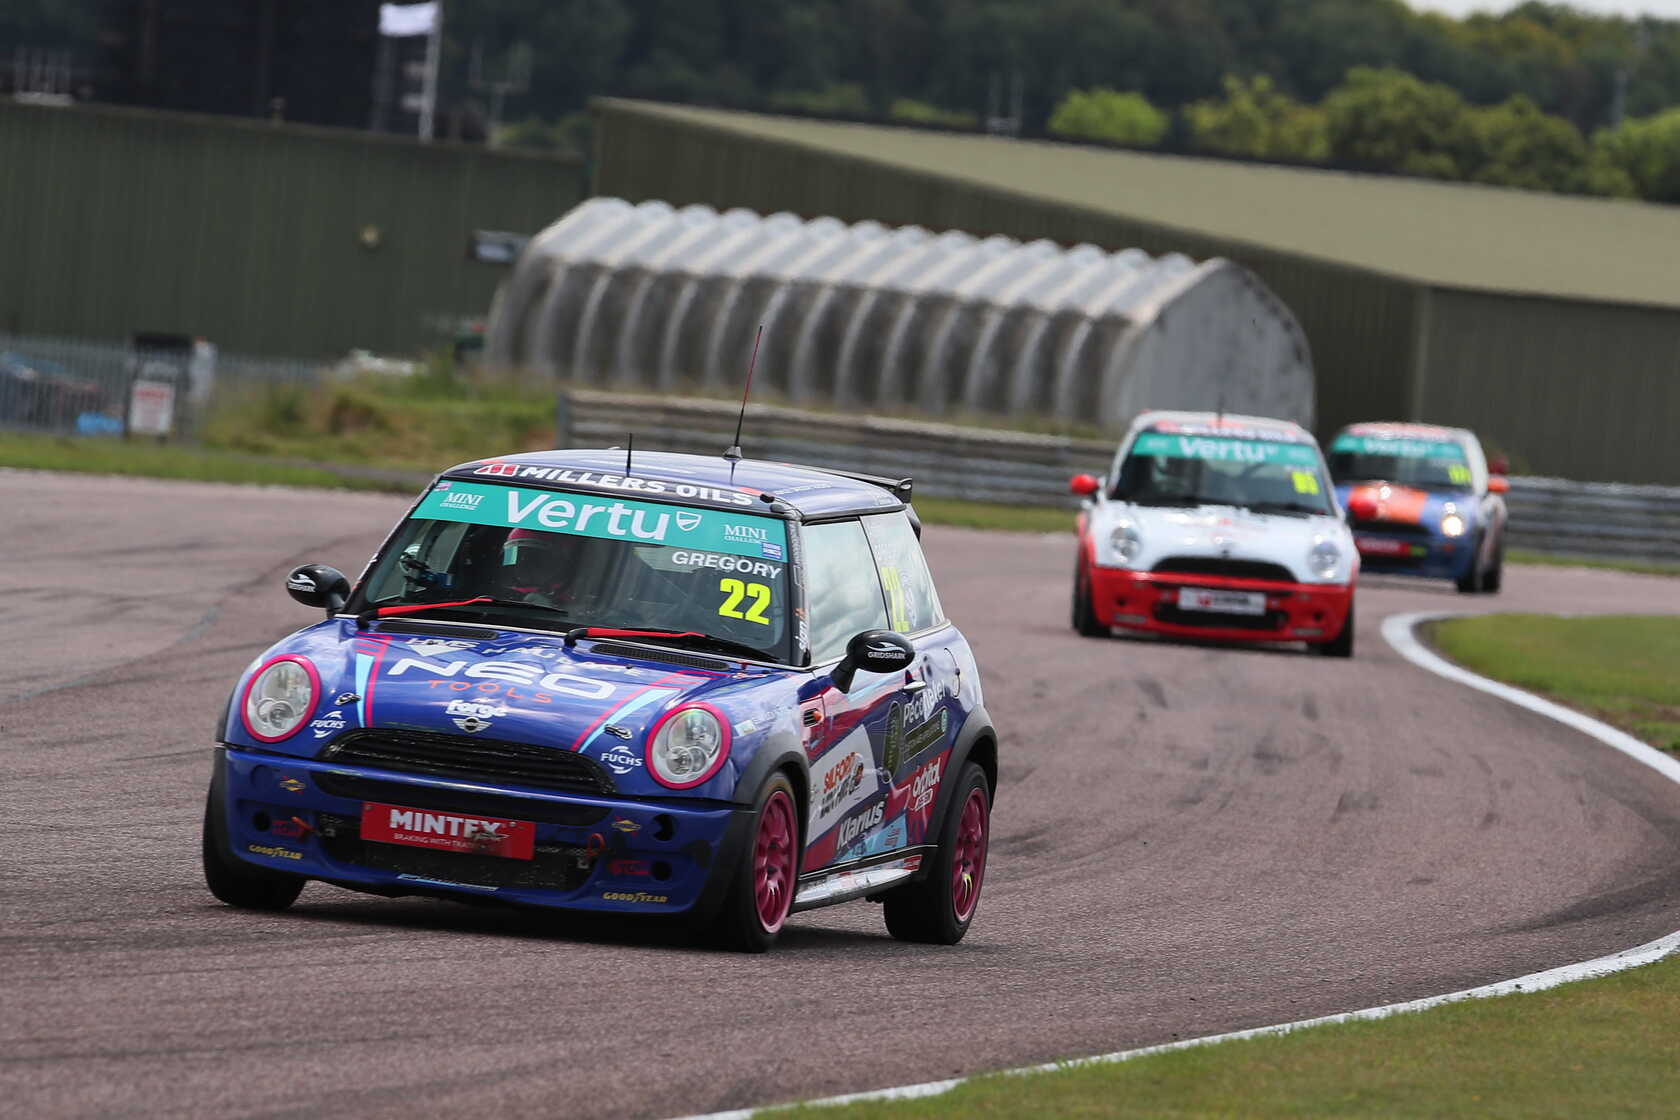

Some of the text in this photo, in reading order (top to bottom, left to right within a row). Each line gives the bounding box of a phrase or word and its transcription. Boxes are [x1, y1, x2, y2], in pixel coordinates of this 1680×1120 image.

[1178, 437, 1266, 461] Vertu
[518, 466, 753, 506] MILLERS OILS
[443, 492, 485, 506] MINI
[507, 491, 670, 541] Vertu
[724, 524, 768, 540] MINI
[672, 551, 782, 579] GREGORY
[719, 578, 771, 625] 22
[387, 657, 616, 700] NEO
[427, 679, 553, 704] TOOLS
[309, 719, 347, 729] FUCHS
[601, 752, 643, 767] FUCHS
[602, 890, 669, 903] GOODYEAR
